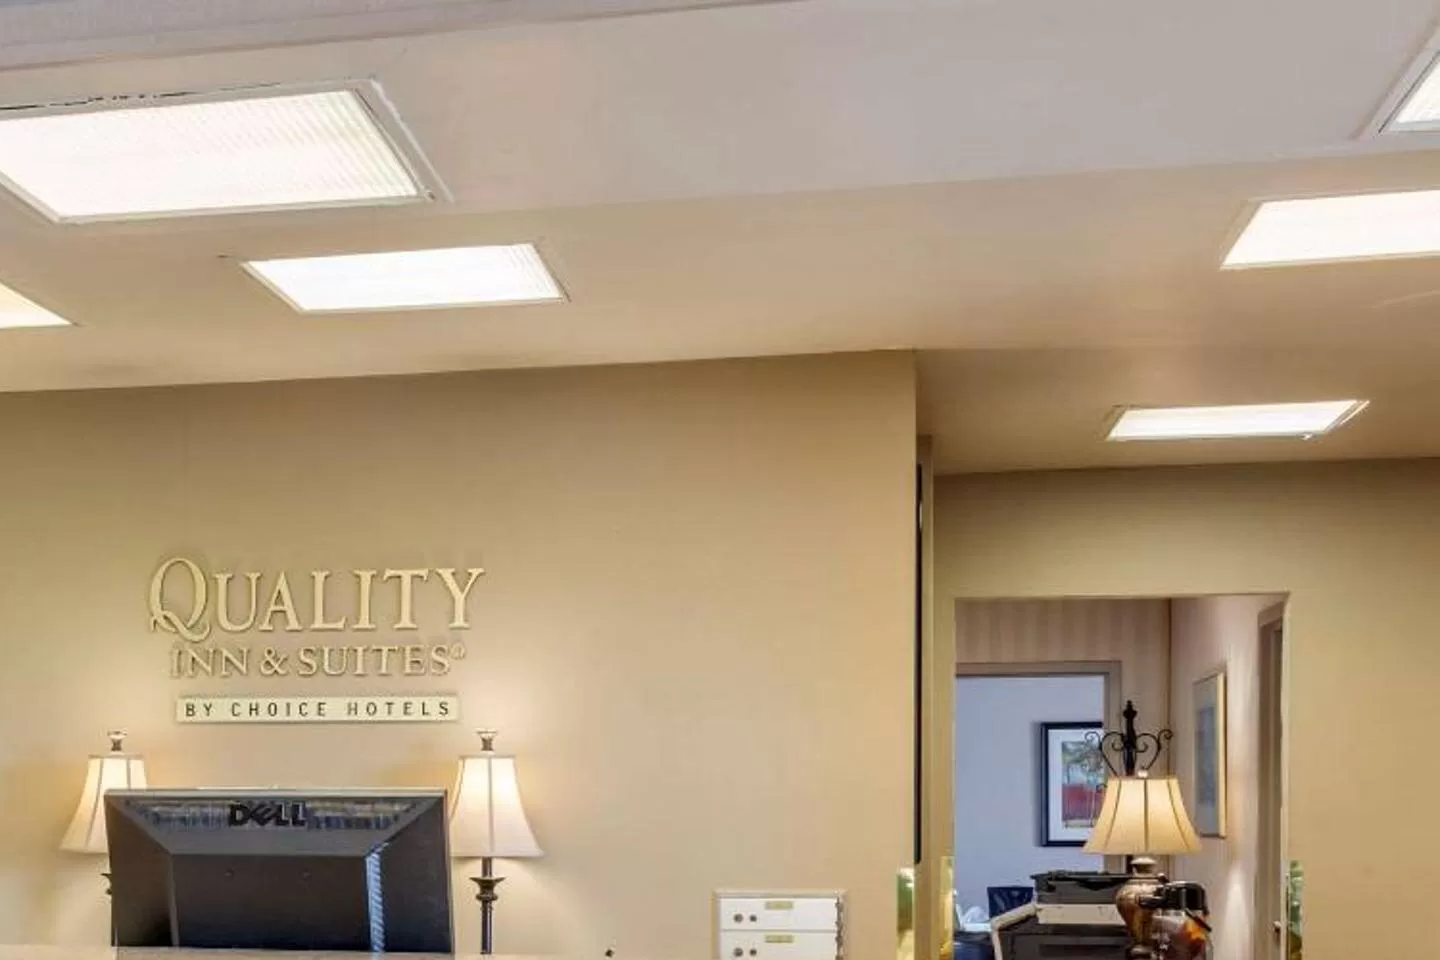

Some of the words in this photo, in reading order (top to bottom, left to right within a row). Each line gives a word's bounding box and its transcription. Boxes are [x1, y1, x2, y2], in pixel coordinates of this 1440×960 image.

[168, 646, 250, 679] INN
[259, 646, 290, 677] &
[184, 700, 215, 718] BY
[231, 700, 328, 718] CHOICE
[346, 700, 451, 718] HOTELS
[228, 802, 306, 828] DELL
